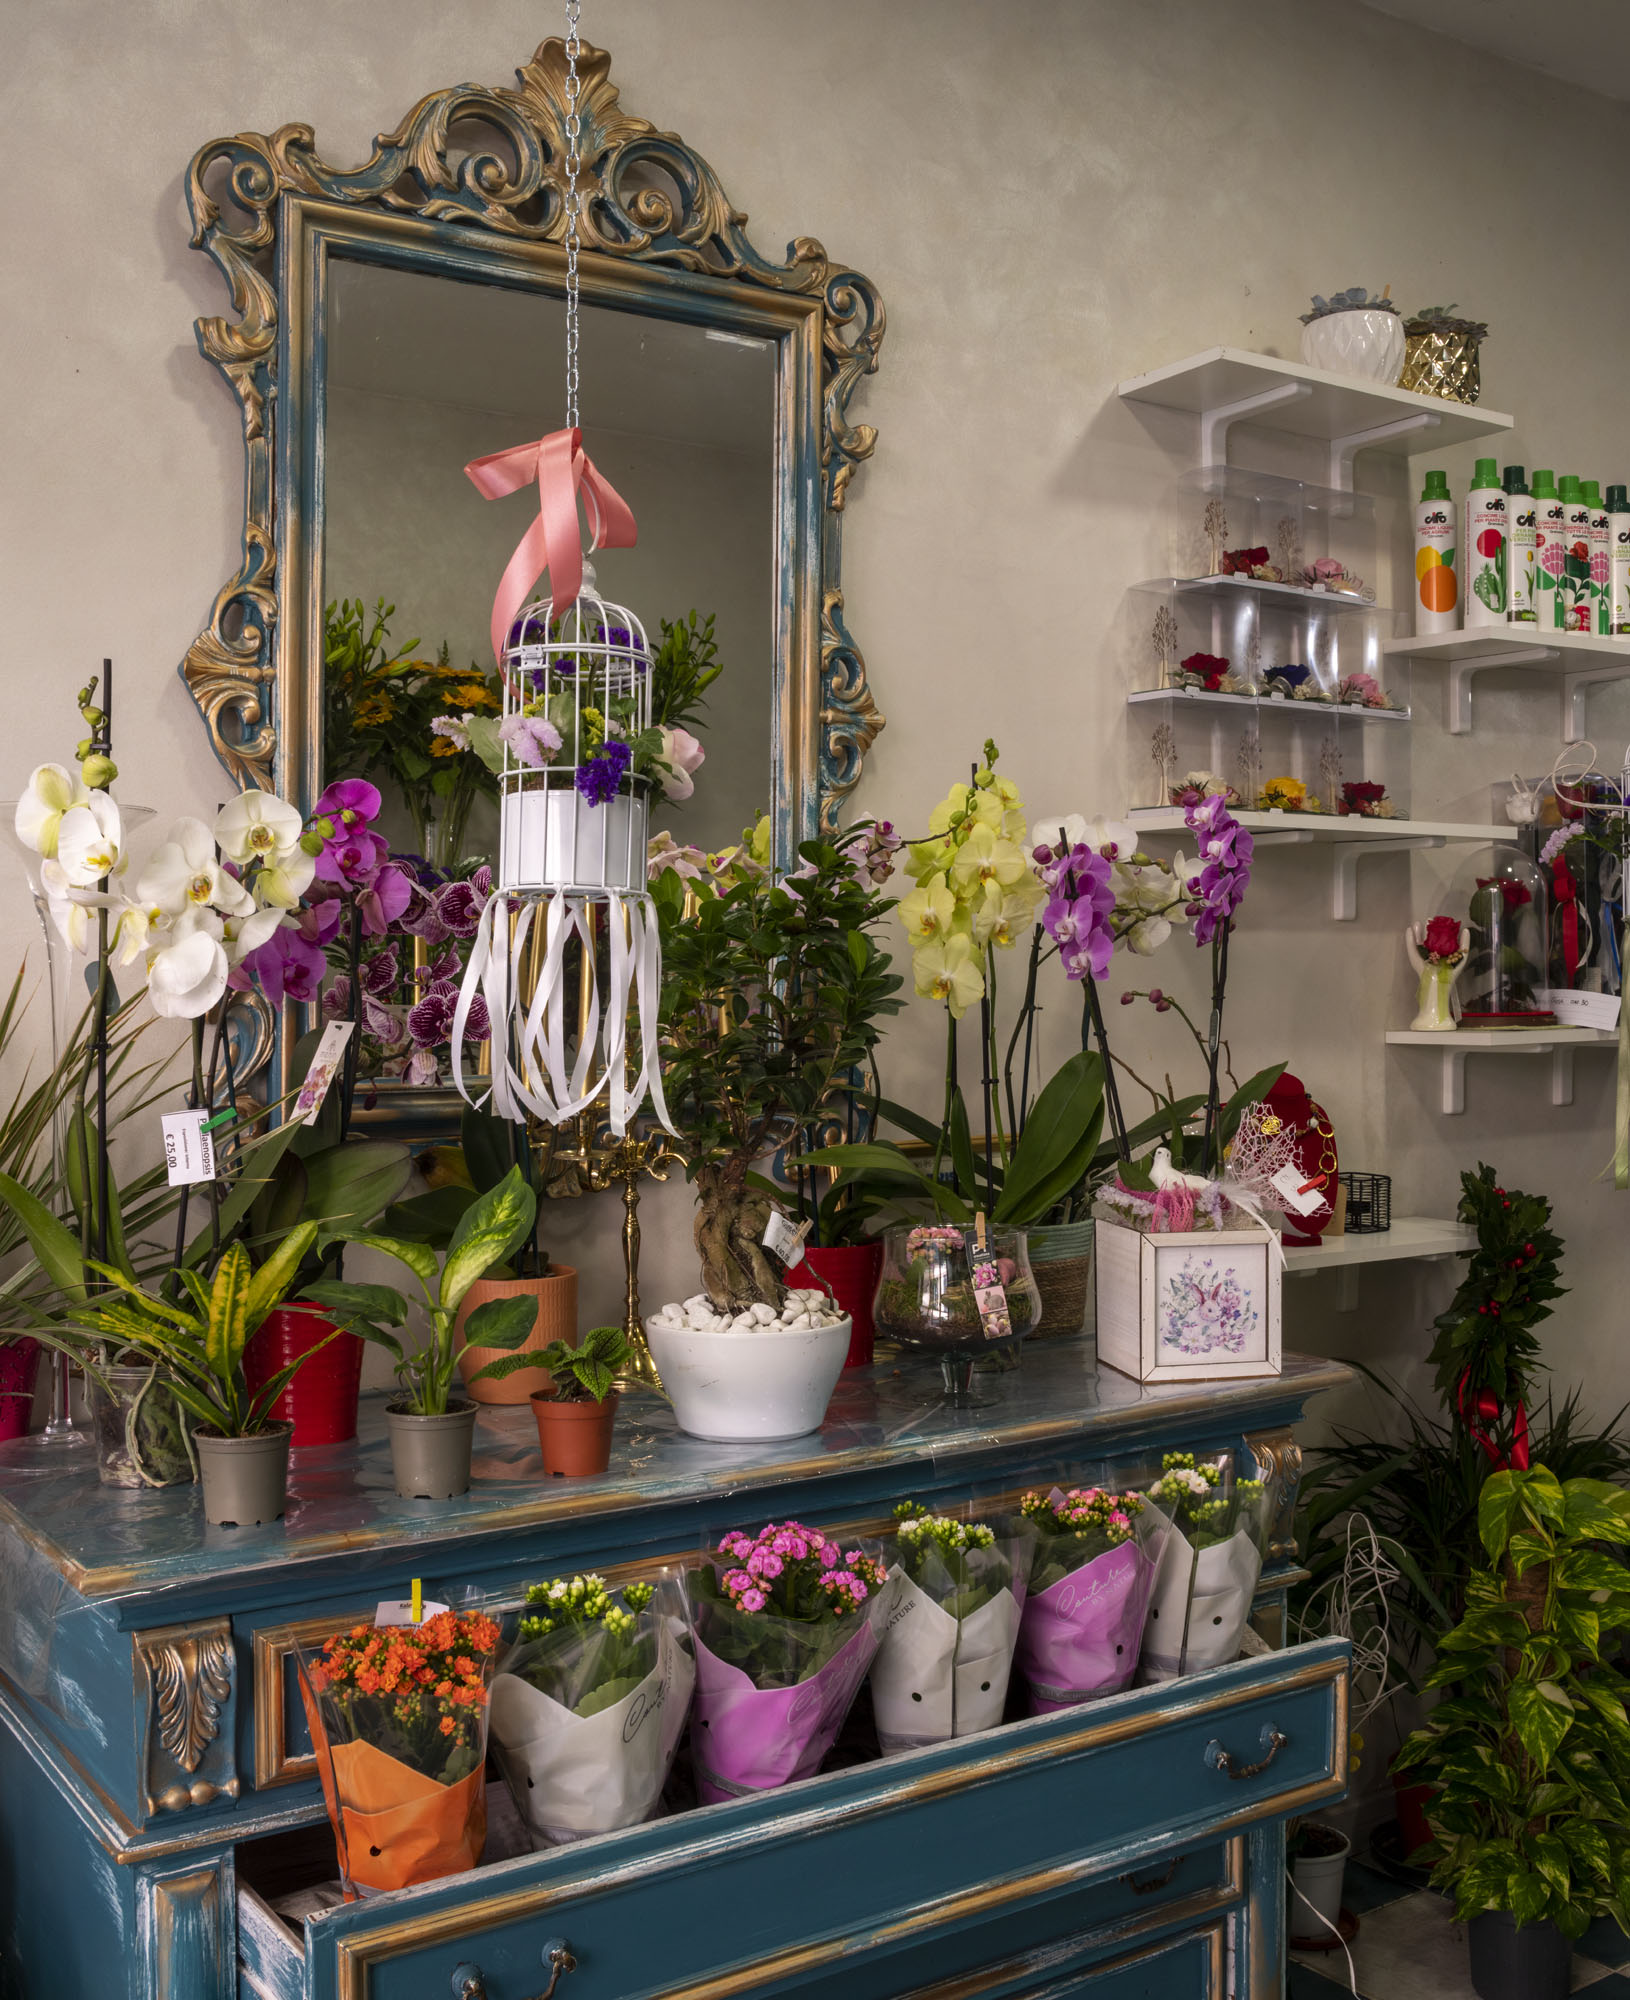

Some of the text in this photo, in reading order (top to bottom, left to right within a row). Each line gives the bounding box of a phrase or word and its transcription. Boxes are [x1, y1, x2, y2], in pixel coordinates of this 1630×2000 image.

[1424, 511, 1447, 524] cifo
[166, 1142, 177, 1168] 25,00
[199, 1117, 213, 1175] Plaenopsis
